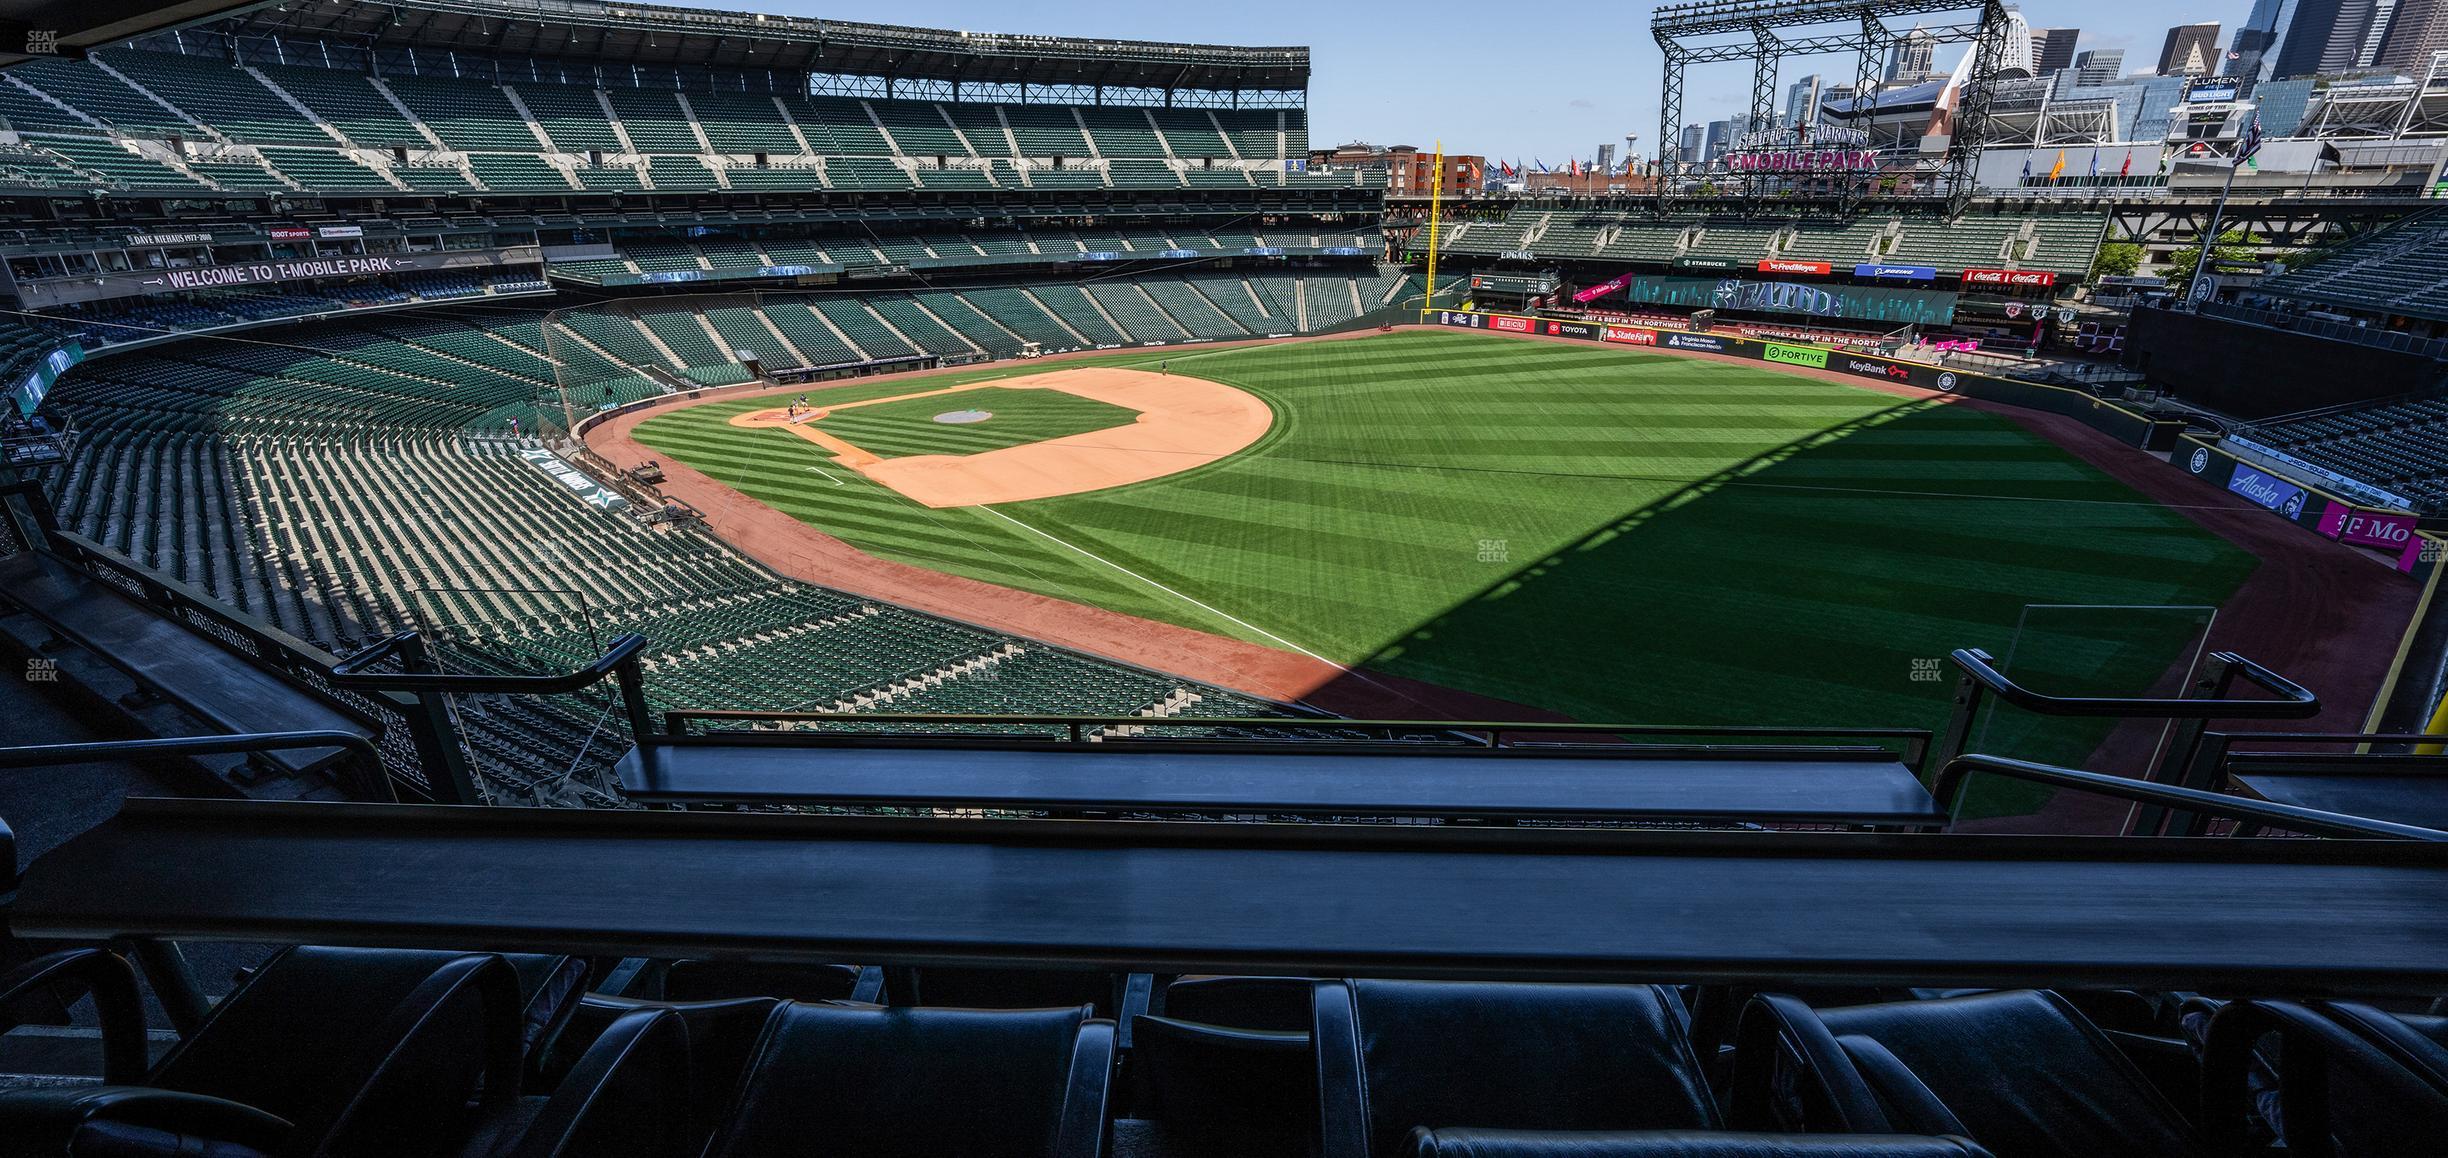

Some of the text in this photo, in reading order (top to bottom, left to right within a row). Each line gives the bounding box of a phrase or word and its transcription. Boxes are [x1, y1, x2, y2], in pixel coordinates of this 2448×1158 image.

[2194, 77, 2239, 86] LUMEN
[1814, 124, 1869, 145] MARINERS
[1725, 150, 1880, 170] T-MOBILE PARK
[134, 233, 212, 245] DAVE NIEHAUS 1977-2010
[167, 257, 392, 289] WELCOME TO T-MOBILE PARK
[2034, 309, 2043, 317] 24
[1499, 319, 1525, 329] BECU
[1561, 326, 1588, 334] TOYOTA
[1644, 320, 1687, 328] NORTHWEST
[1781, 350, 1823, 363] FORTIVE
[1849, 360, 1887, 375] KeyBank
[2234, 474, 2279, 504] Alaska
